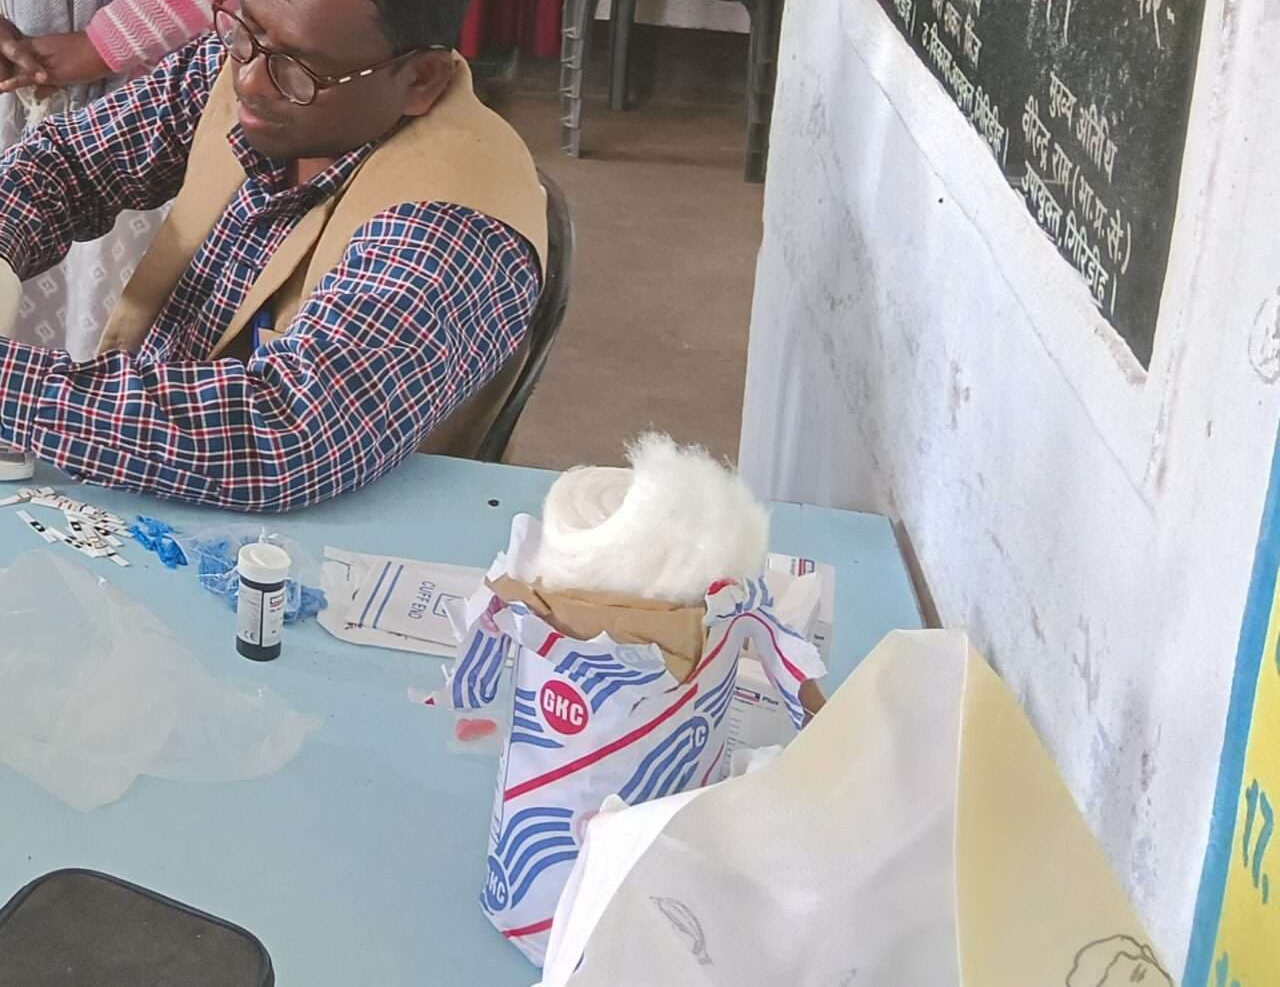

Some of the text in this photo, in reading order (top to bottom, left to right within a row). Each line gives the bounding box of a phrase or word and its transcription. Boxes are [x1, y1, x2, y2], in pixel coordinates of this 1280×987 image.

[1023, 96, 1050, 170] वीरेन्द्र
[1053, 143, 1072, 190] राम
[1050, 72, 1117, 182] मुख्य अतिथि
[408, 581, 436, 620] CUFF END
[542, 687, 585, 727] GKC
[487, 875, 507, 903] KC
